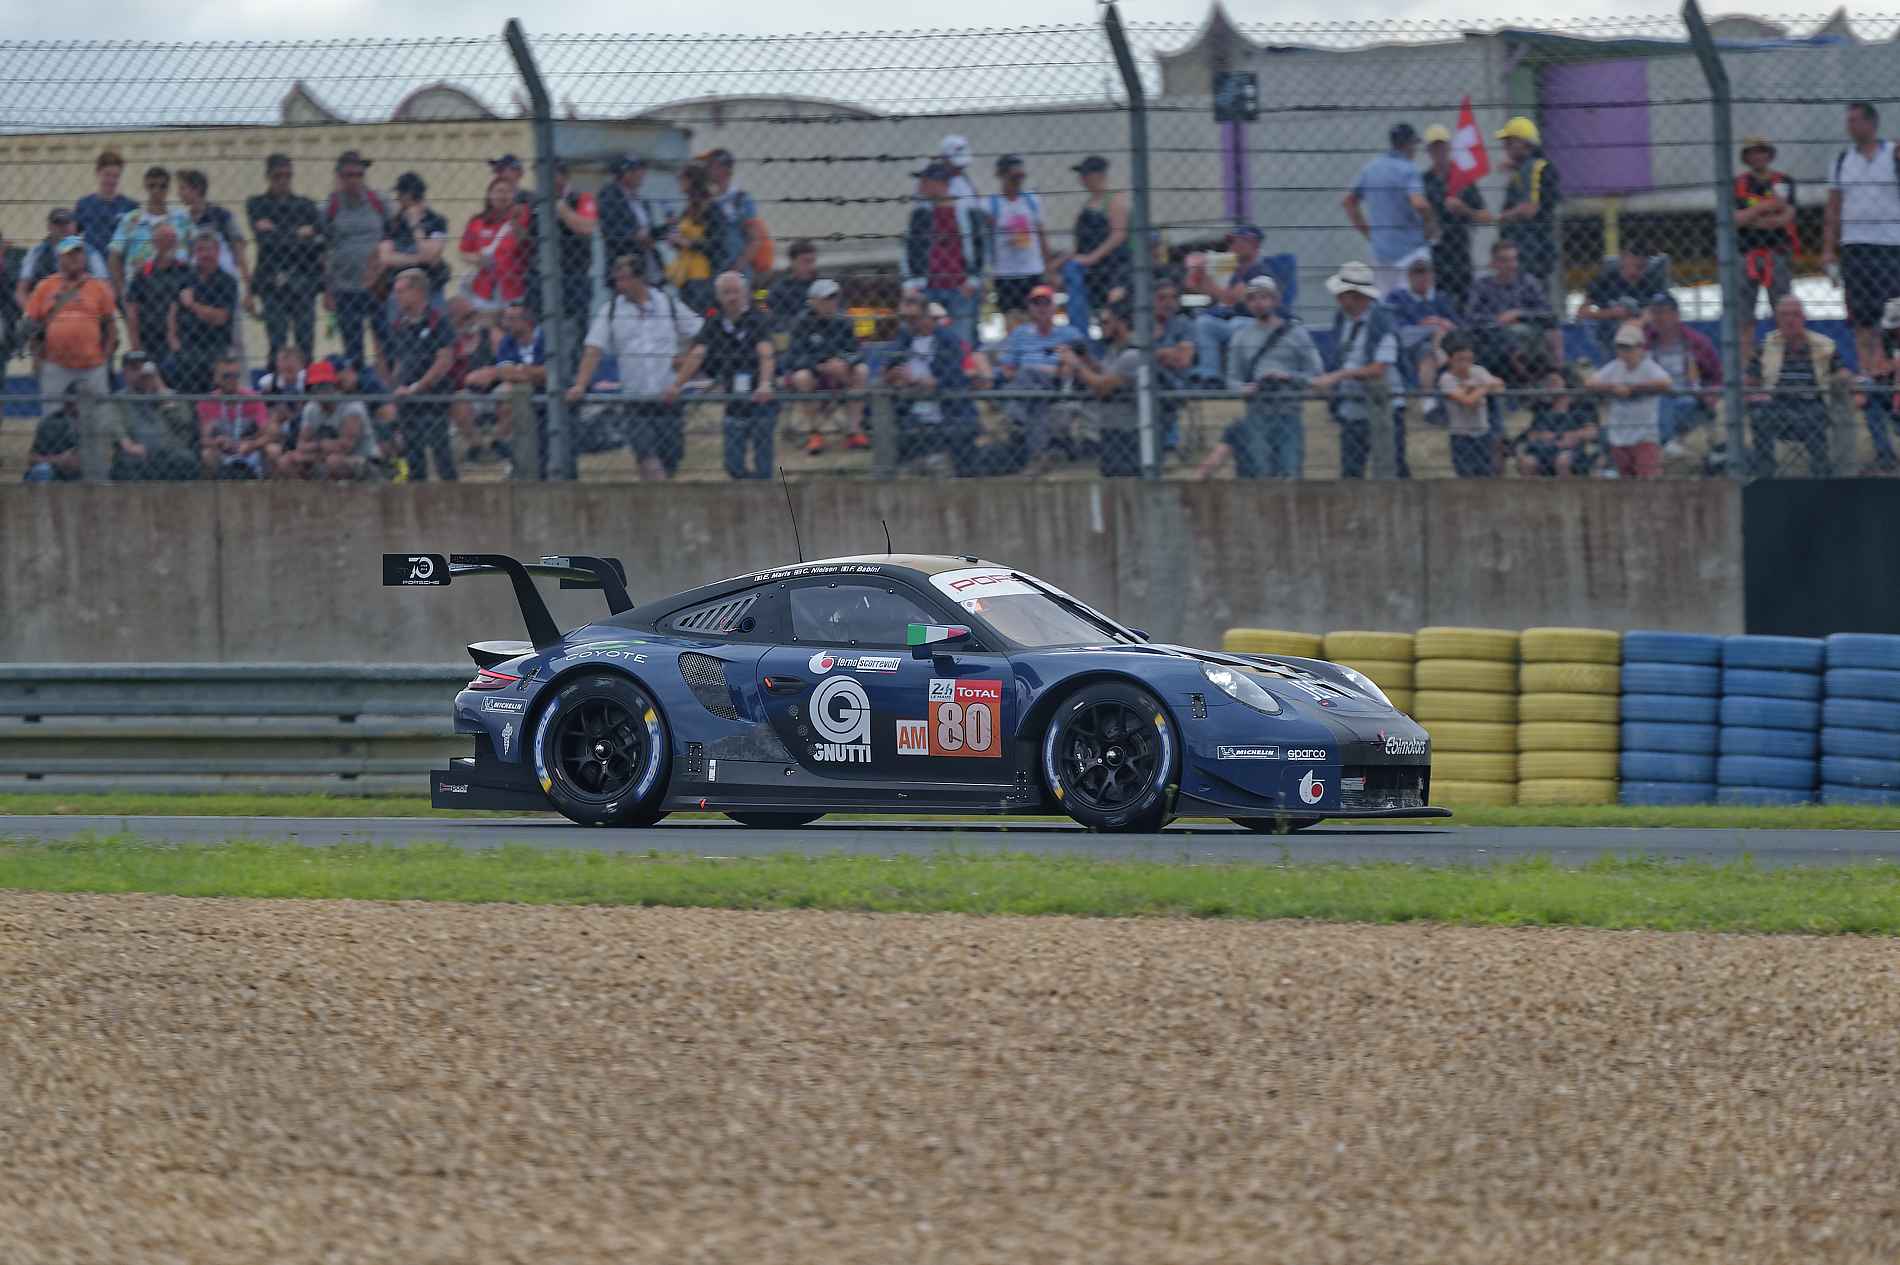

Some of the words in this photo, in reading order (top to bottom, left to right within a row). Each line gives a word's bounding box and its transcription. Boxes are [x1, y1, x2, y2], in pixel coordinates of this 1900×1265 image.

[565, 650, 648, 664] COYOTE
[937, 701, 993, 752] 80
[898, 726, 927, 749] AM
[813, 742, 872, 763] GNUTTI
[1287, 749, 1326, 760] sparco
